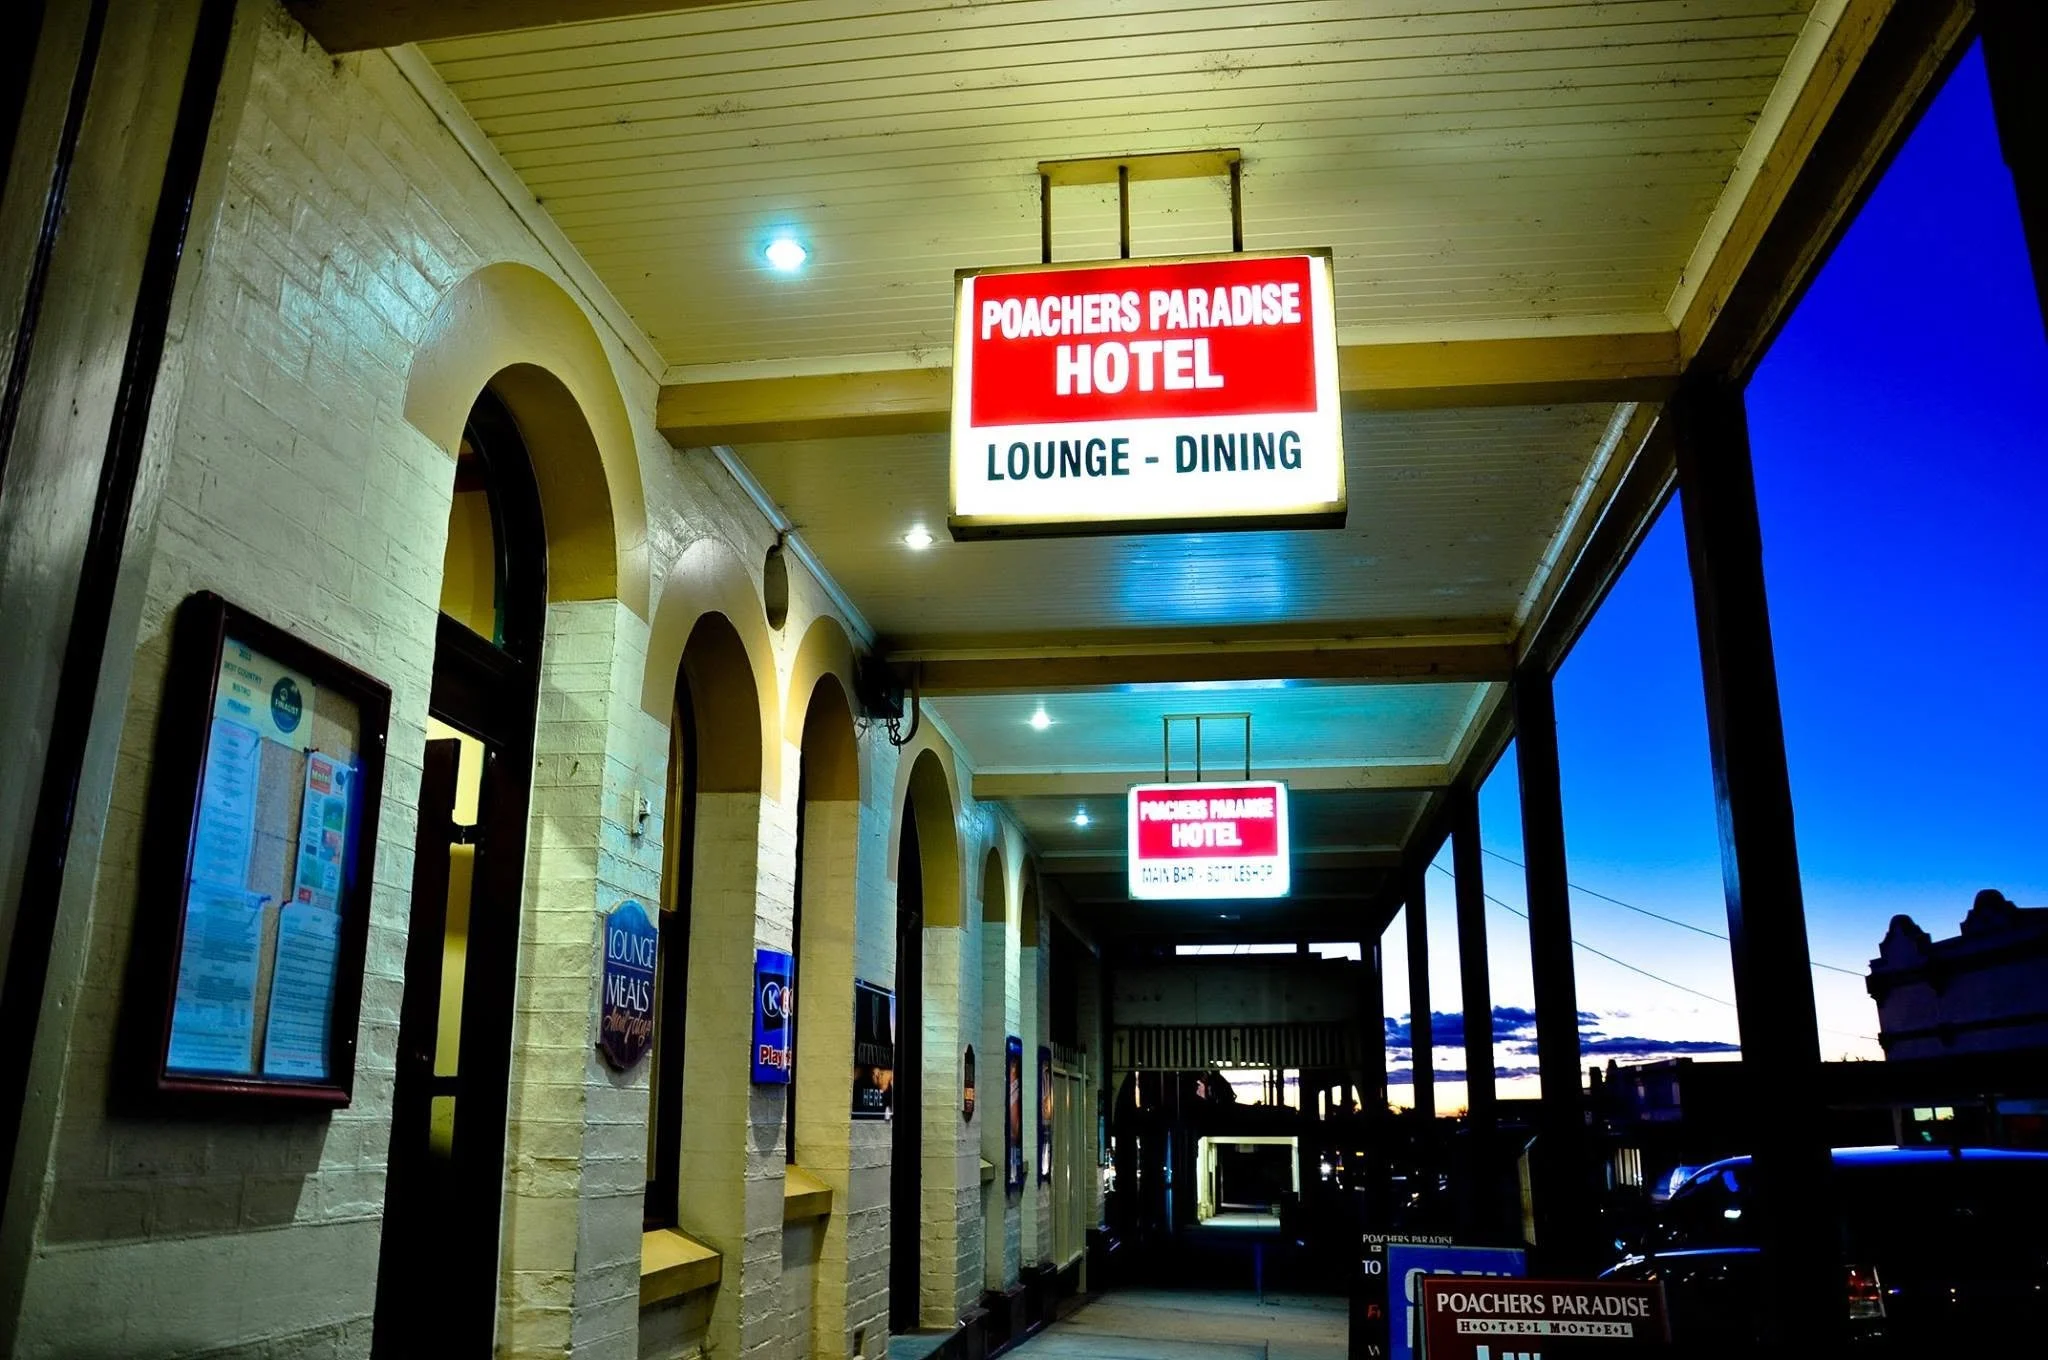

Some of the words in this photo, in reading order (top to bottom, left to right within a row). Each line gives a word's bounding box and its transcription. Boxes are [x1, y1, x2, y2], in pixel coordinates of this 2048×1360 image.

[981, 290, 1141, 340] POACHERS
[1149, 282, 1302, 331] PARADISE
[1055, 338, 1225, 396] HOTEL
[987, 437, 1130, 481] LOUNGE
[1175, 430, 1302, 474] DINING
[1139, 799, 1208, 821] POACHERS
[1209, 797, 1275, 819] PARADISE
[1171, 822, 1243, 847] HOTEL
[1173, 866, 1194, 883] BAR
[608, 927, 655, 968] LOUNGE
[605, 973, 650, 1013] MEALS
[863, 1088, 883, 1107] HERE
[1362, 1233, 1410, 1243] POACHERS
[1411, 1235, 1453, 1244] PARADISE
[1437, 1293, 1545, 1314] POACHERS
[1552, 1295, 1650, 1317] PARADISE
